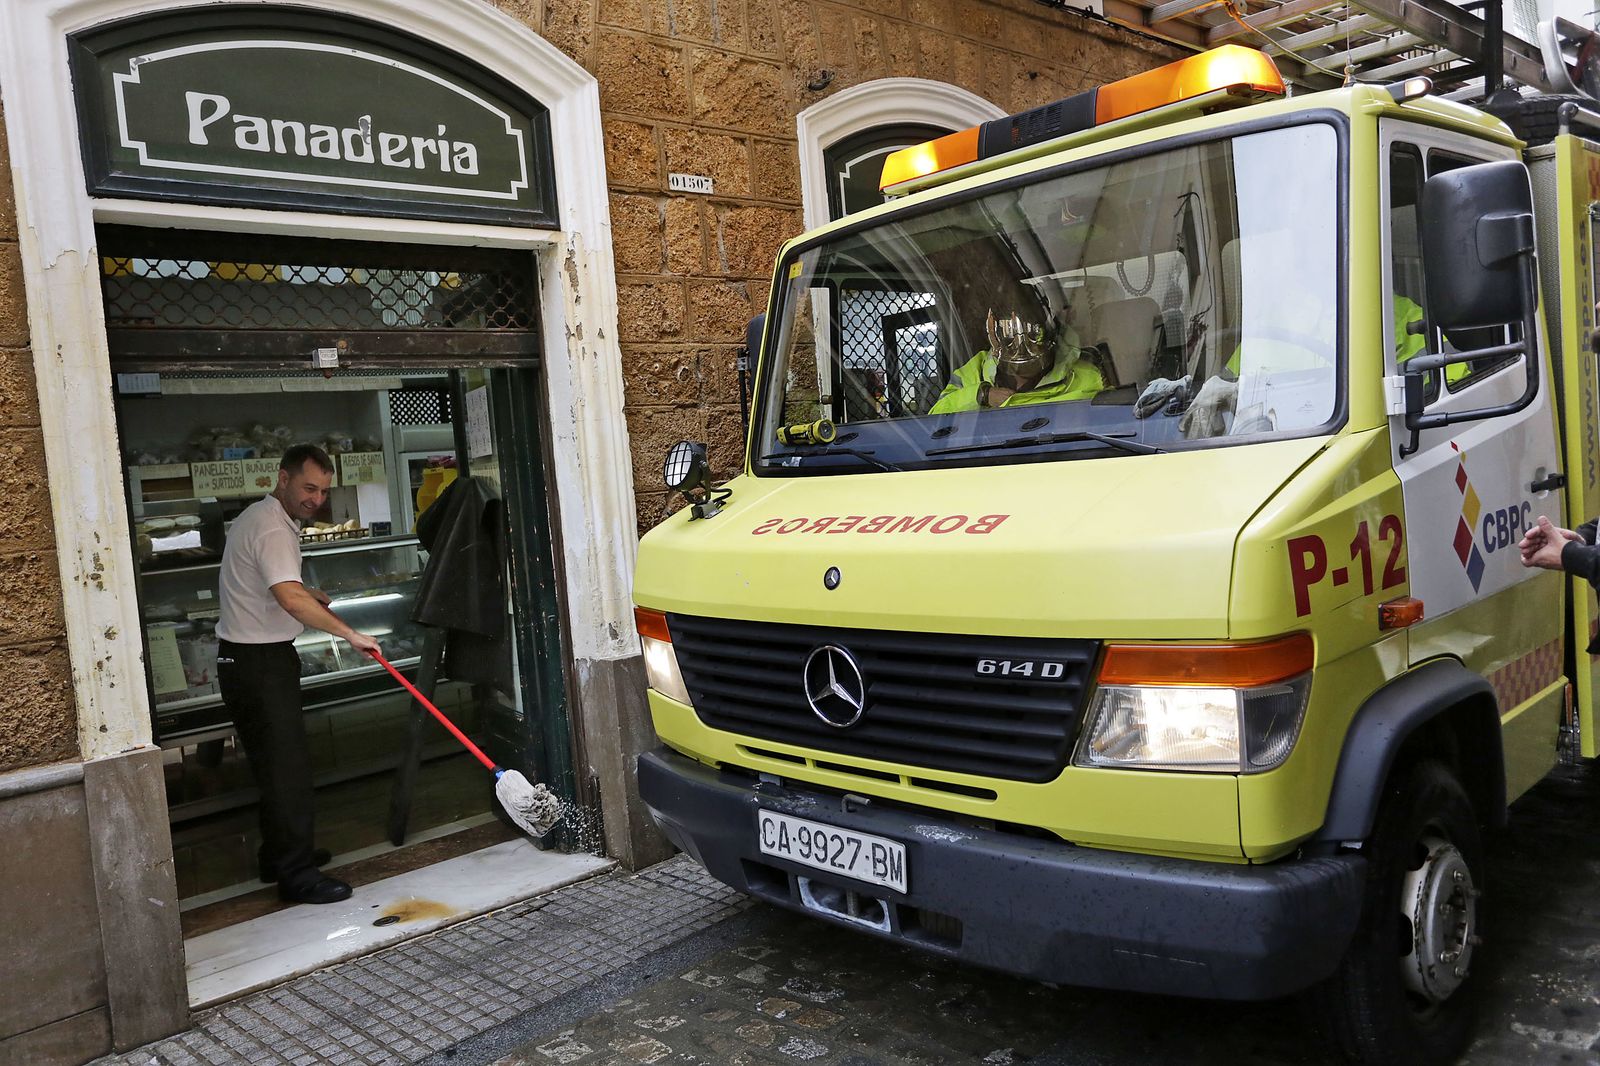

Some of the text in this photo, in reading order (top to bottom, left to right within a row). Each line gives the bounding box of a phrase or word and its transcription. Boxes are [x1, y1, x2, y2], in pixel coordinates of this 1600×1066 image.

[185, 91, 479, 176] Panadería
[671, 176, 710, 191] 01507
[193, 463, 240, 477] PANELLETS
[212, 476, 244, 490] SURTIDOS
[1482, 500, 1533, 554] CBPC
[1287, 514, 1406, 618] P-12
[976, 658, 1064, 679] 614 D
